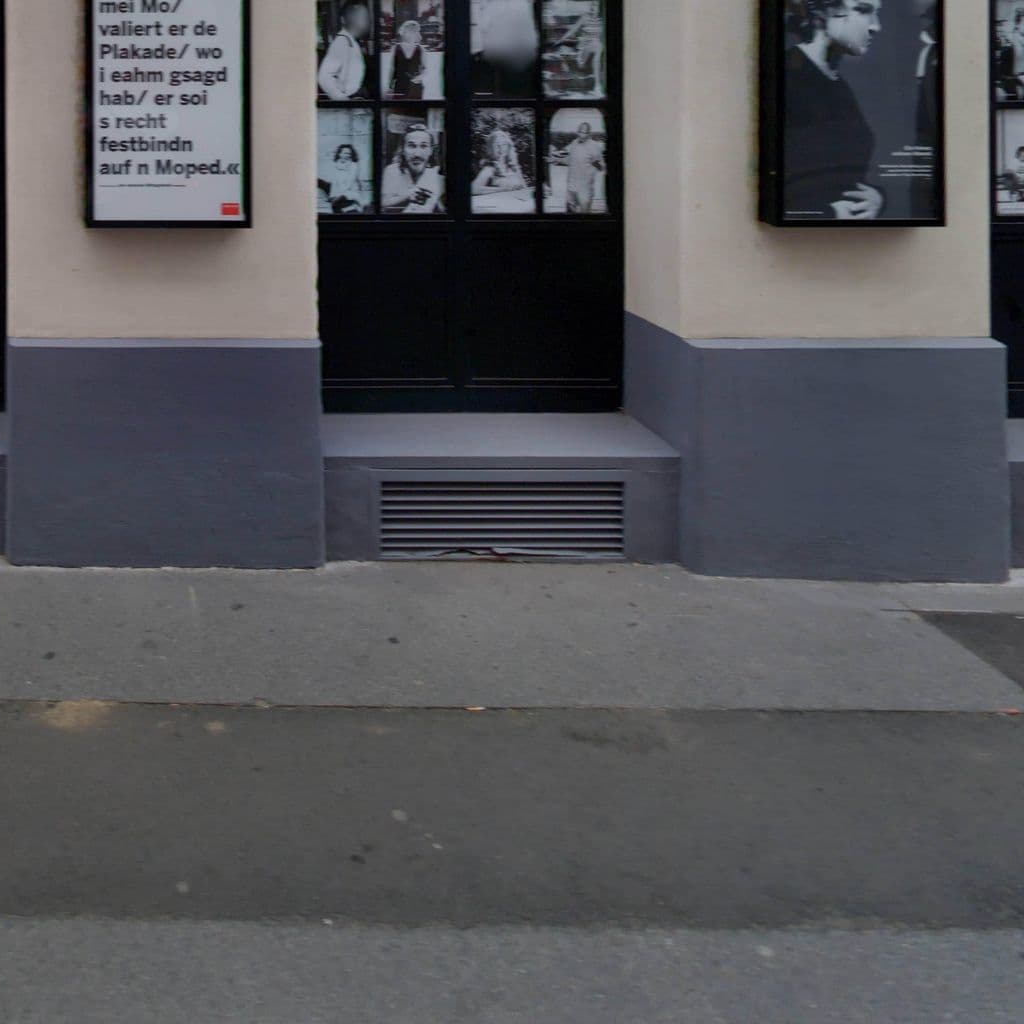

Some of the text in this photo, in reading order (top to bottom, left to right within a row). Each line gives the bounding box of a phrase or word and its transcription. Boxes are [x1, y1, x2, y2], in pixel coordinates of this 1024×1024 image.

[98, 21, 217, 36] valiert er de
[99, 44, 223, 59] Plakade/ wo
[99, 67, 227, 86] i eahm gsagd
[100, 90, 207, 105] hab/ er soi
[99, 114, 166, 129] s recht
[99, 136, 193, 152] festbindn
[99, 159, 240, 179] auf n Moped.«
